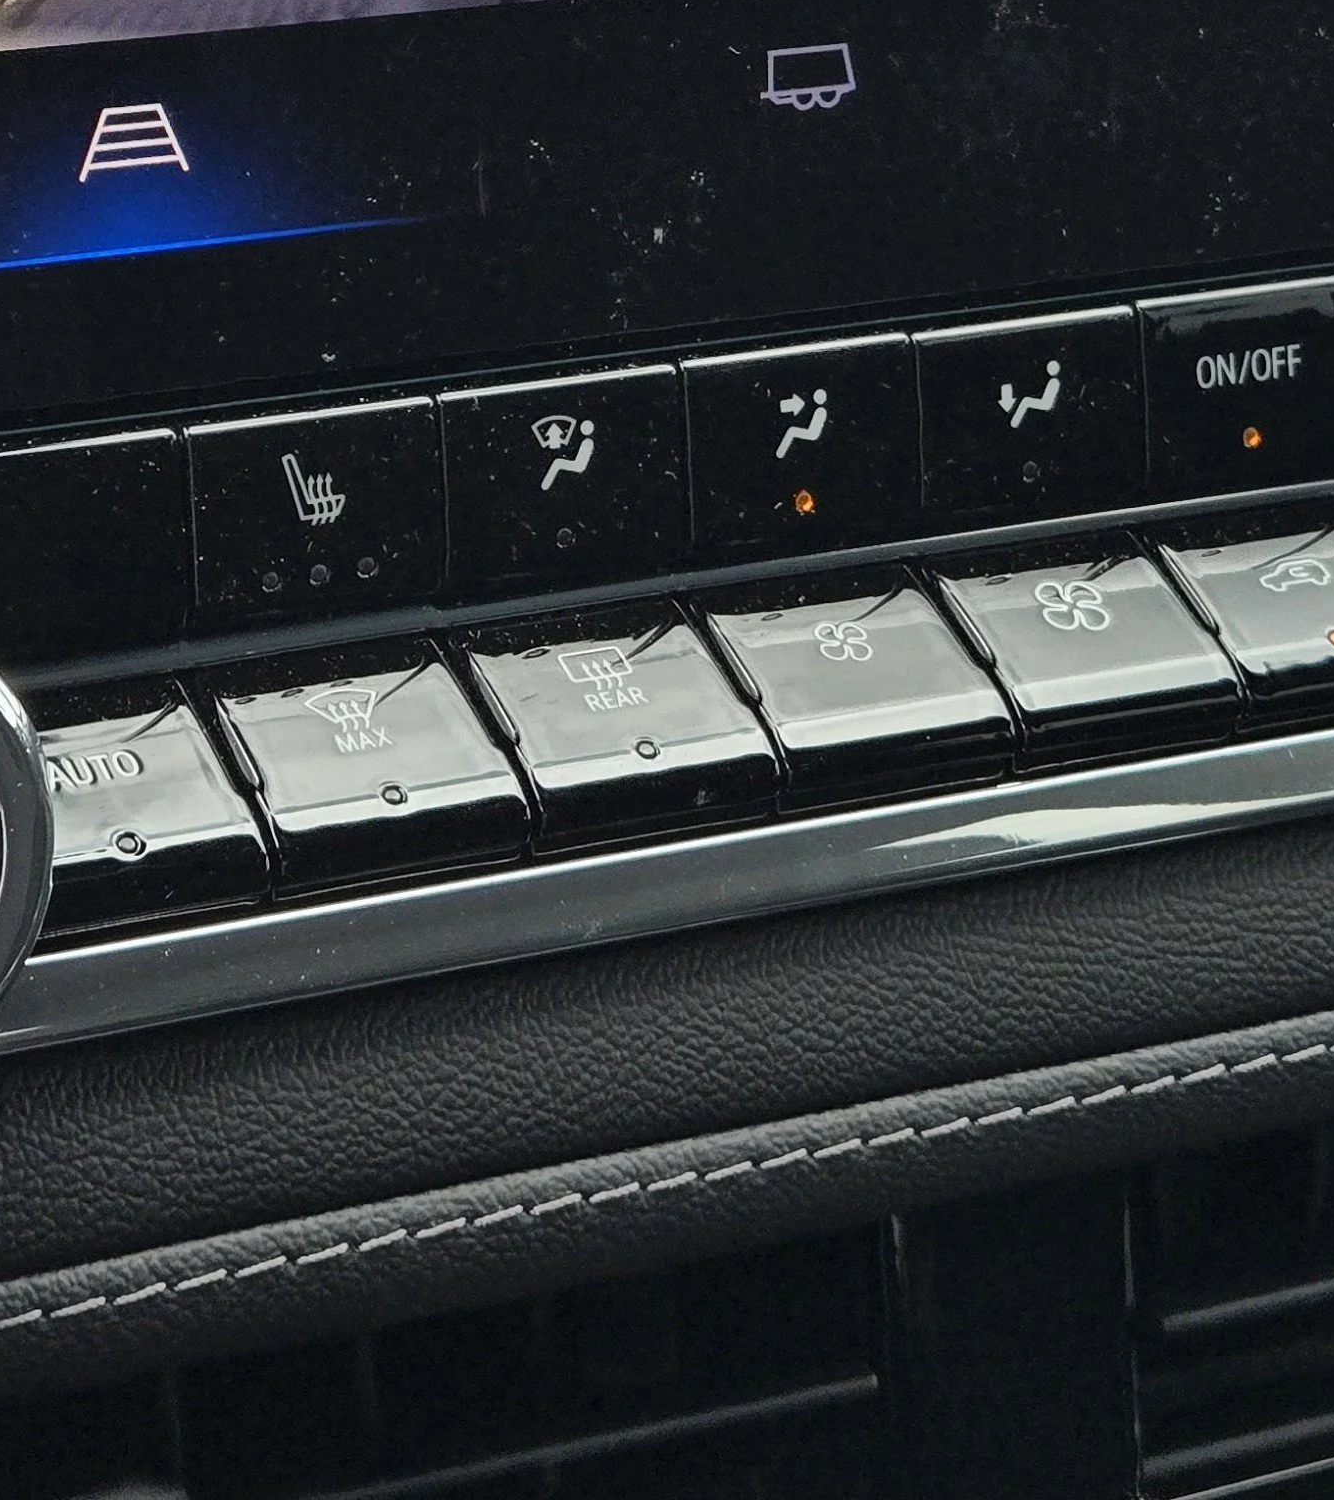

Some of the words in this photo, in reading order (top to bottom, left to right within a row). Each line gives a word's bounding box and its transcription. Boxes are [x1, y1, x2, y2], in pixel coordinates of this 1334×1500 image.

[1196, 343, 1302, 390] ON/OFF
[583, 686, 649, 713] REAR
[333, 728, 393, 754] MAX
[46, 748, 144, 793] AUTO
